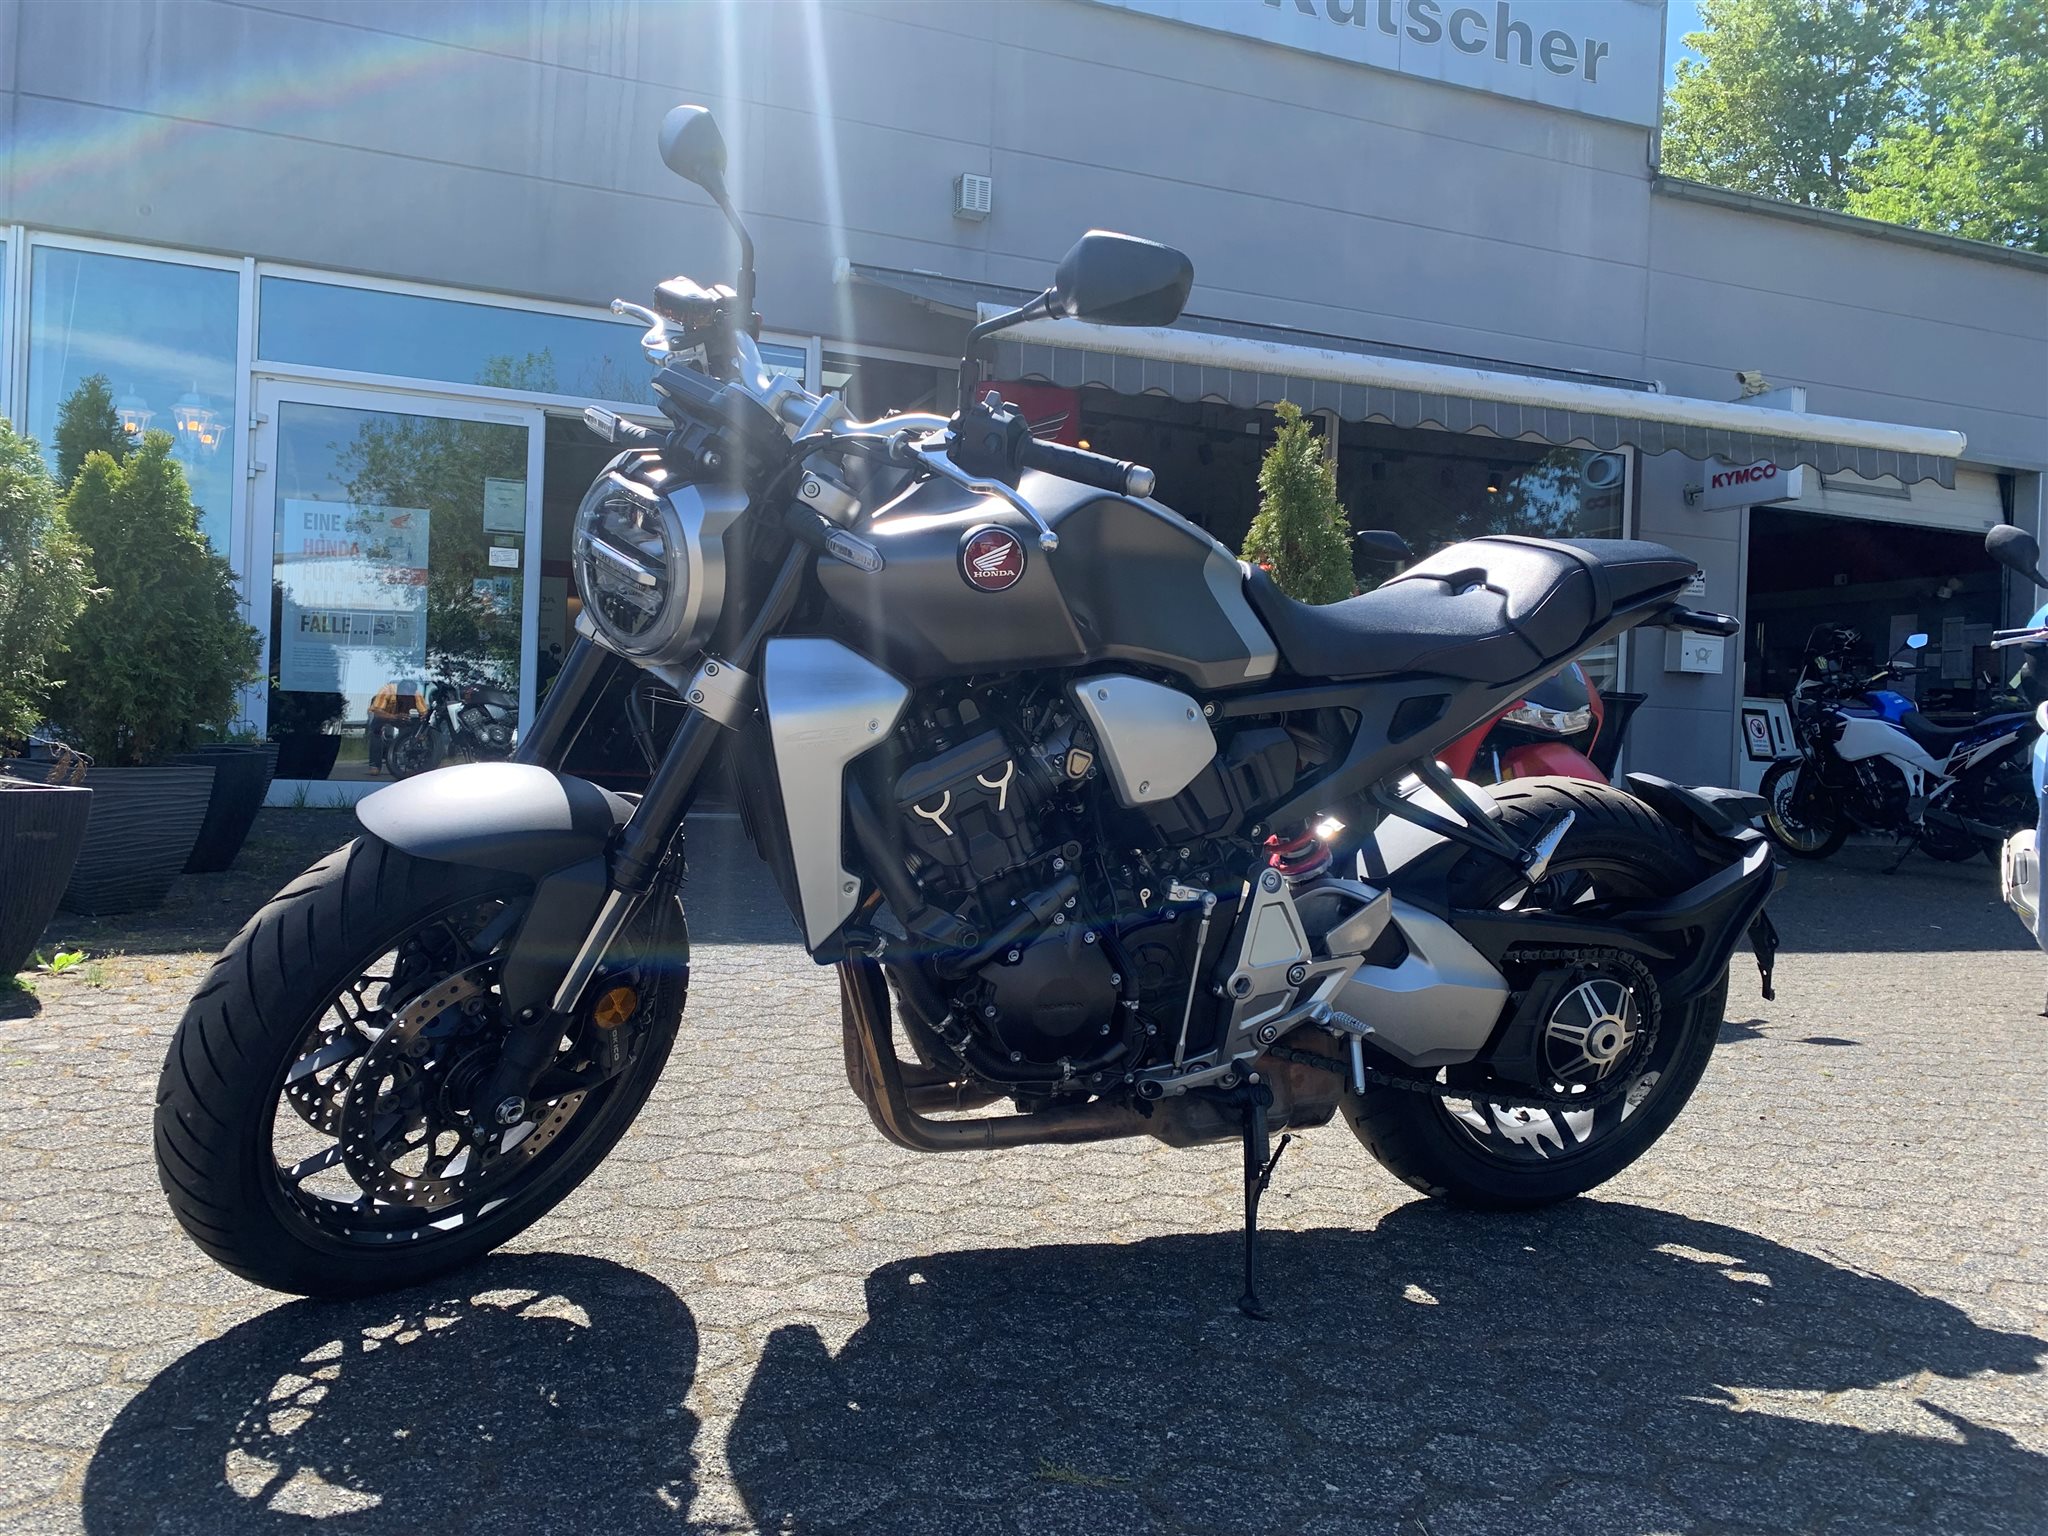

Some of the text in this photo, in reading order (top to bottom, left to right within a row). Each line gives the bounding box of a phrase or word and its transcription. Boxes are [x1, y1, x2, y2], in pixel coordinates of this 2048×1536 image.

[1263, 0, 1609, 83] utscher
[1711, 463, 1777, 489] KYMCO
[303, 512, 341, 532] EINE
[303, 538, 360, 558] HONDA
[973, 569, 1016, 578] HONDA
[611, 1028, 621, 1062] OKICO
